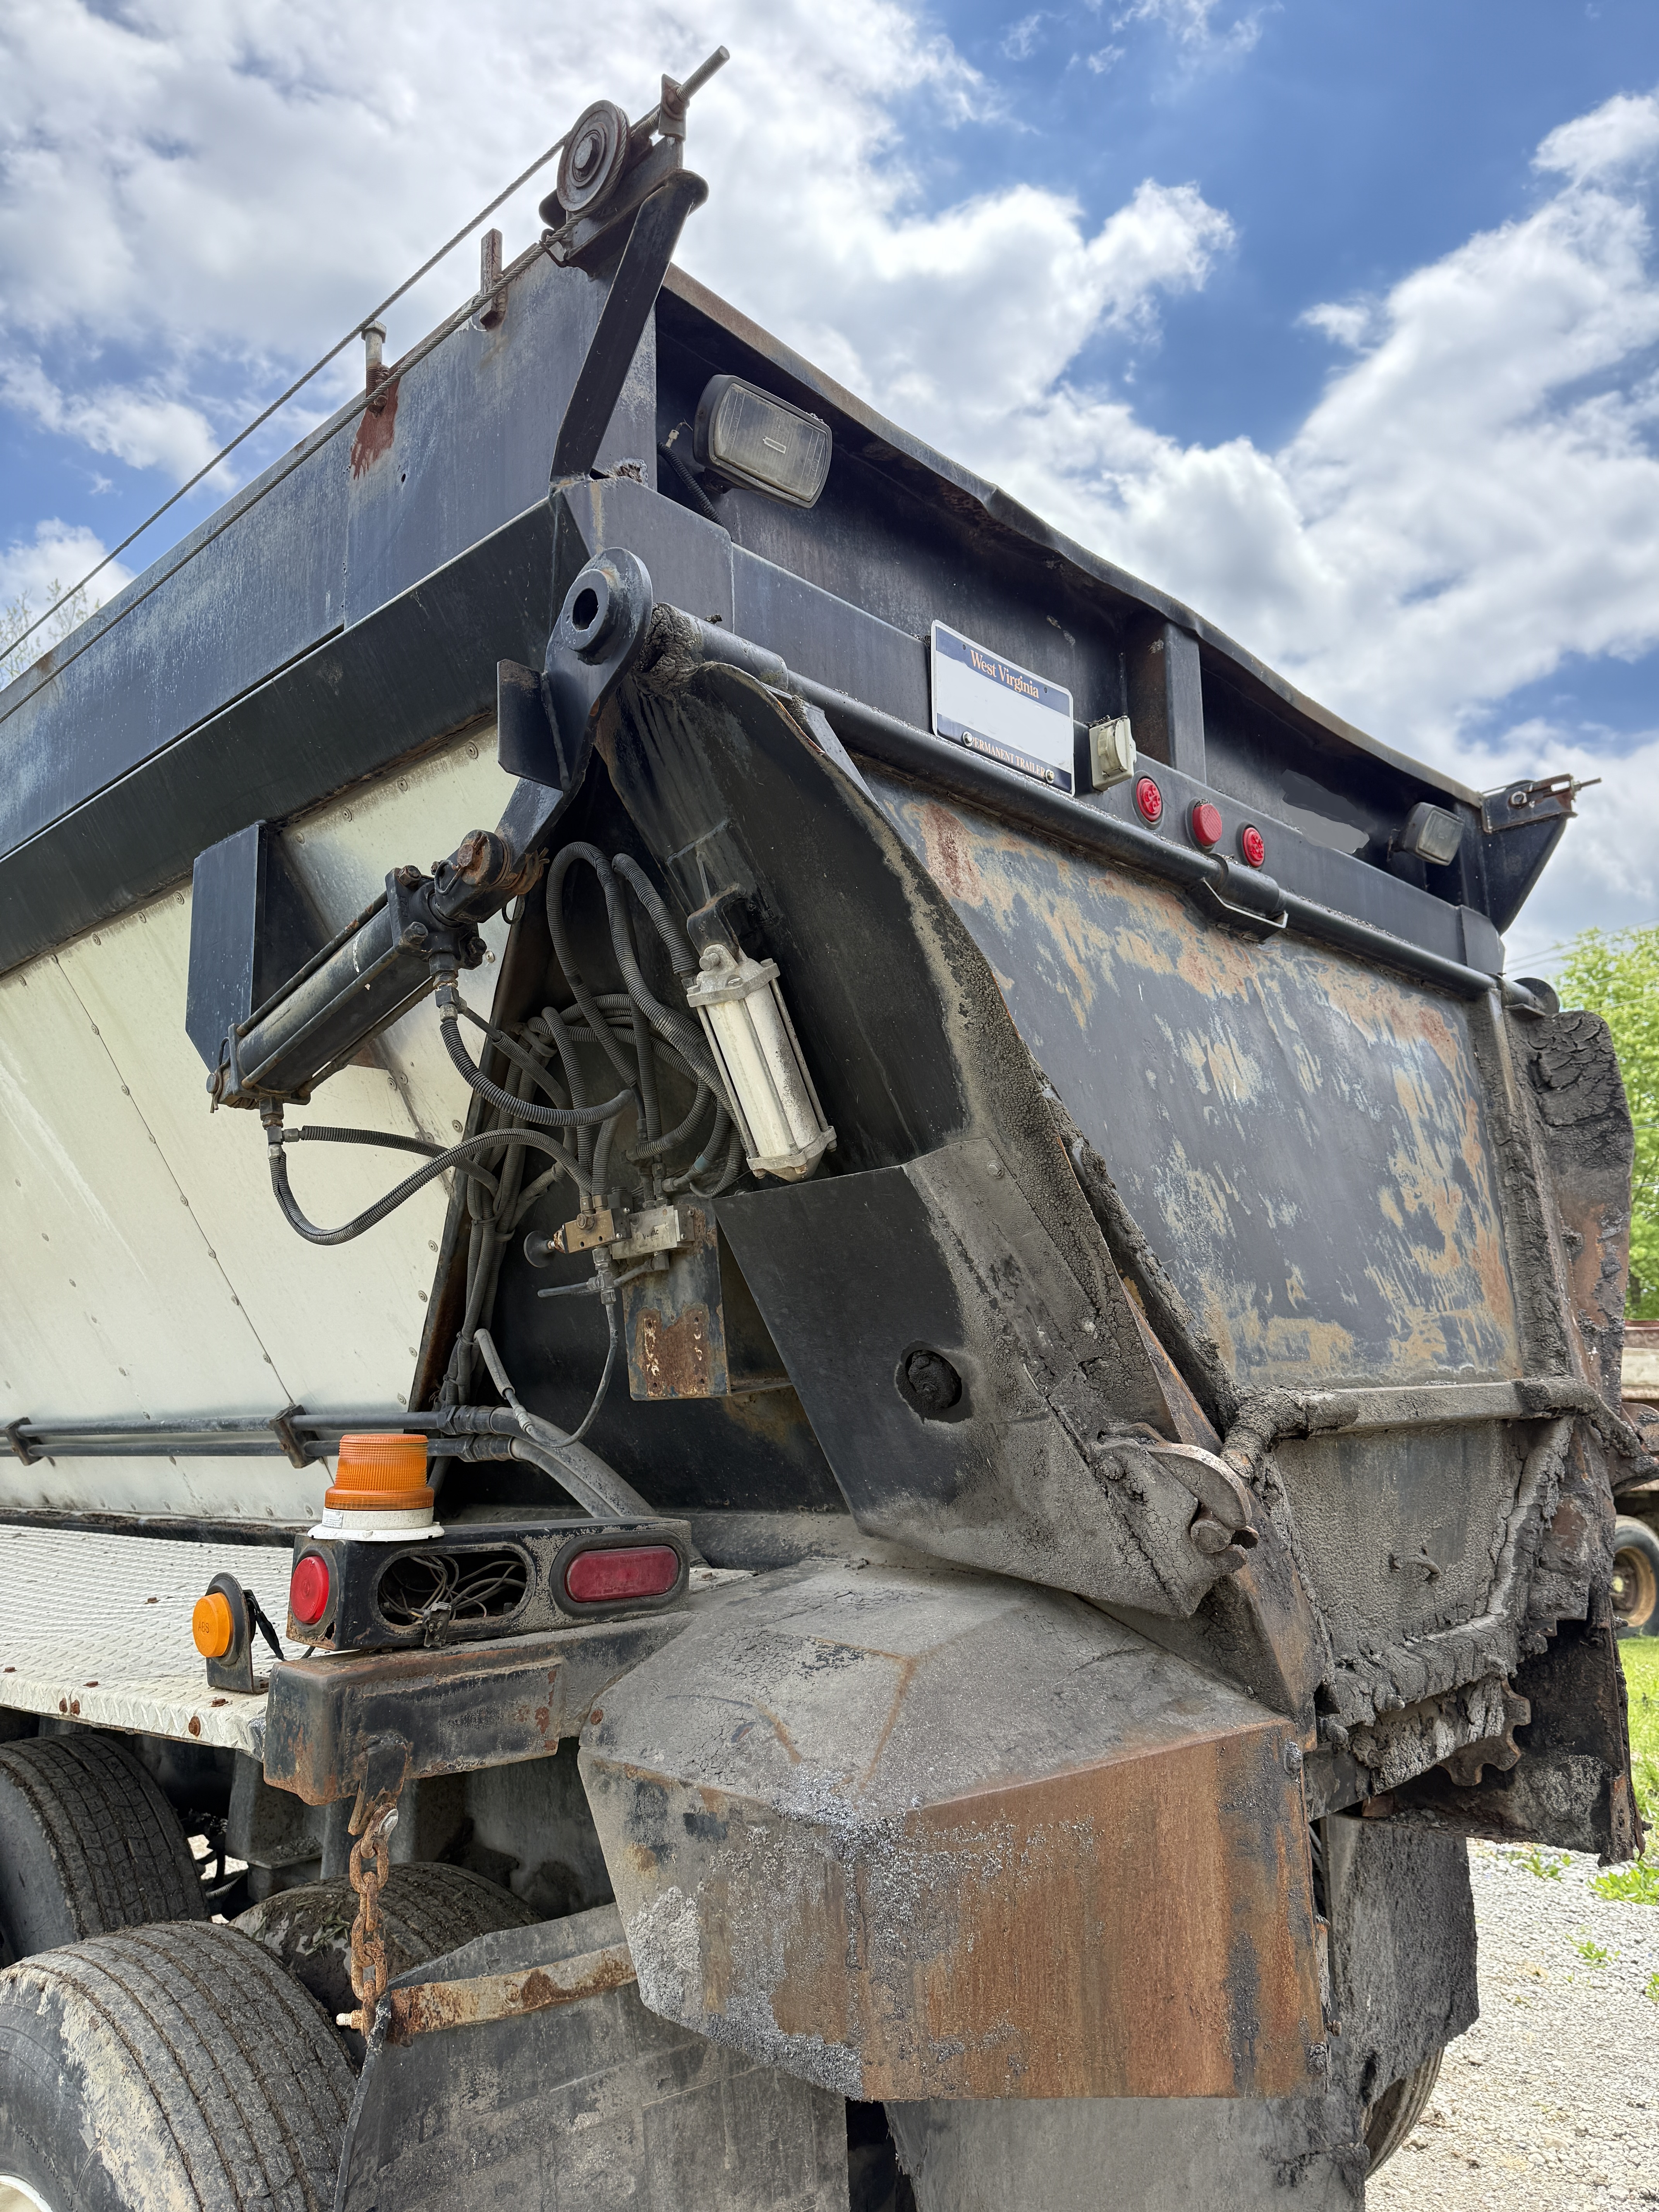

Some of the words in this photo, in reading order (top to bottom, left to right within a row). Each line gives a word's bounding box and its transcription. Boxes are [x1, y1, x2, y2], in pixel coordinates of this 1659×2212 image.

[970, 649, 997, 677] West
[998, 664, 1039, 699] Virginia
[1015, 756, 1045, 777] TRAILER
[198, 1620, 210, 1633] ABS
